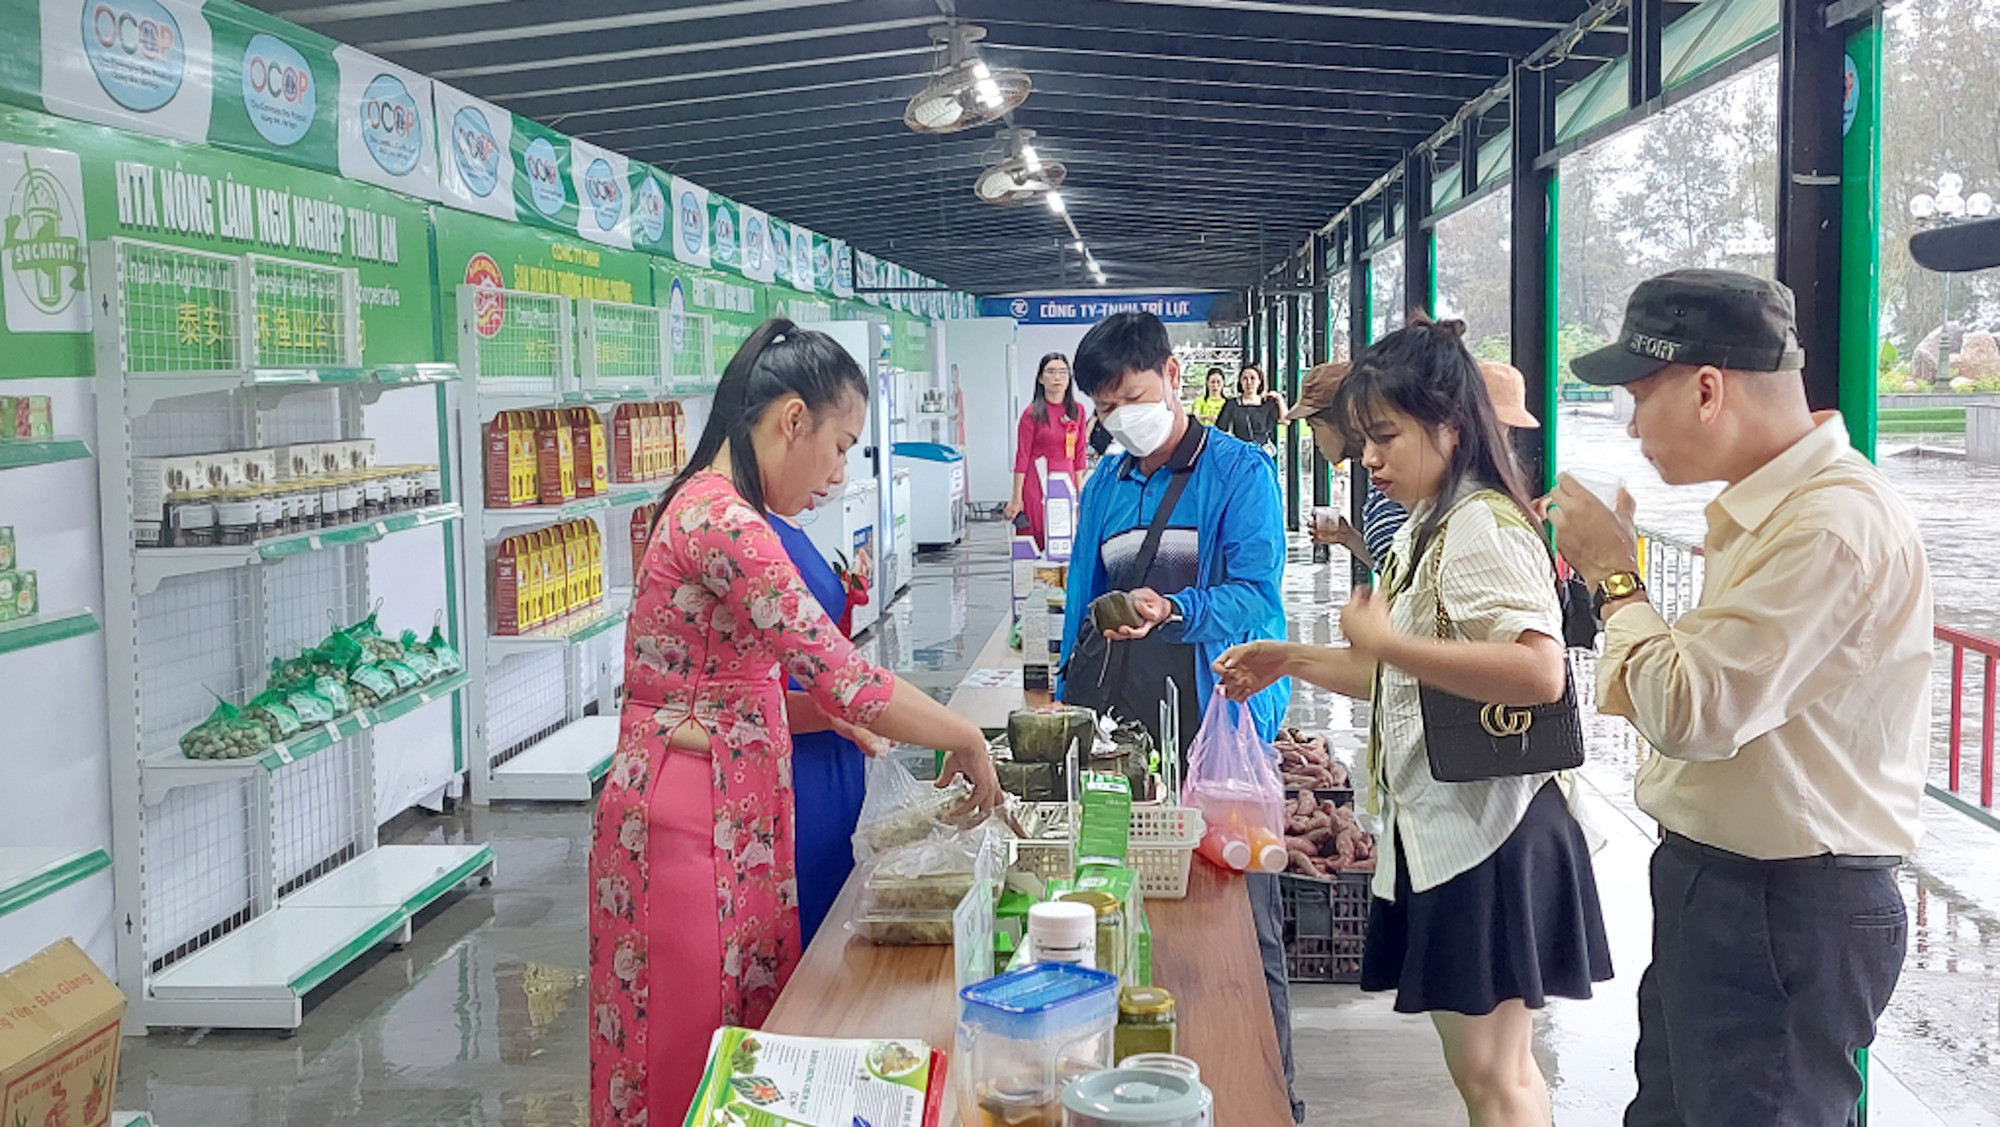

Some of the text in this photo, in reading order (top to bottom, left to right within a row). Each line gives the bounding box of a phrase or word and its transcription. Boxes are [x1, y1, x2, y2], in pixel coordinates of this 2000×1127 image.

[94, 4, 174, 60] OCOP
[250, 55, 309, 105] OCOP
[367, 98, 416, 137] OCOP
[115, 161, 398, 263] HTX NÔNG LÂM NGƯ NGHIỆP THÁI AN
[1040, 299, 1076, 318] CÔNG
[1166, 300, 1191, 318] LỰC
[1630, 333, 1682, 361] SPORT
[34, 988, 61, 1007] Bắc
[58, 972, 94, 995] Giang
